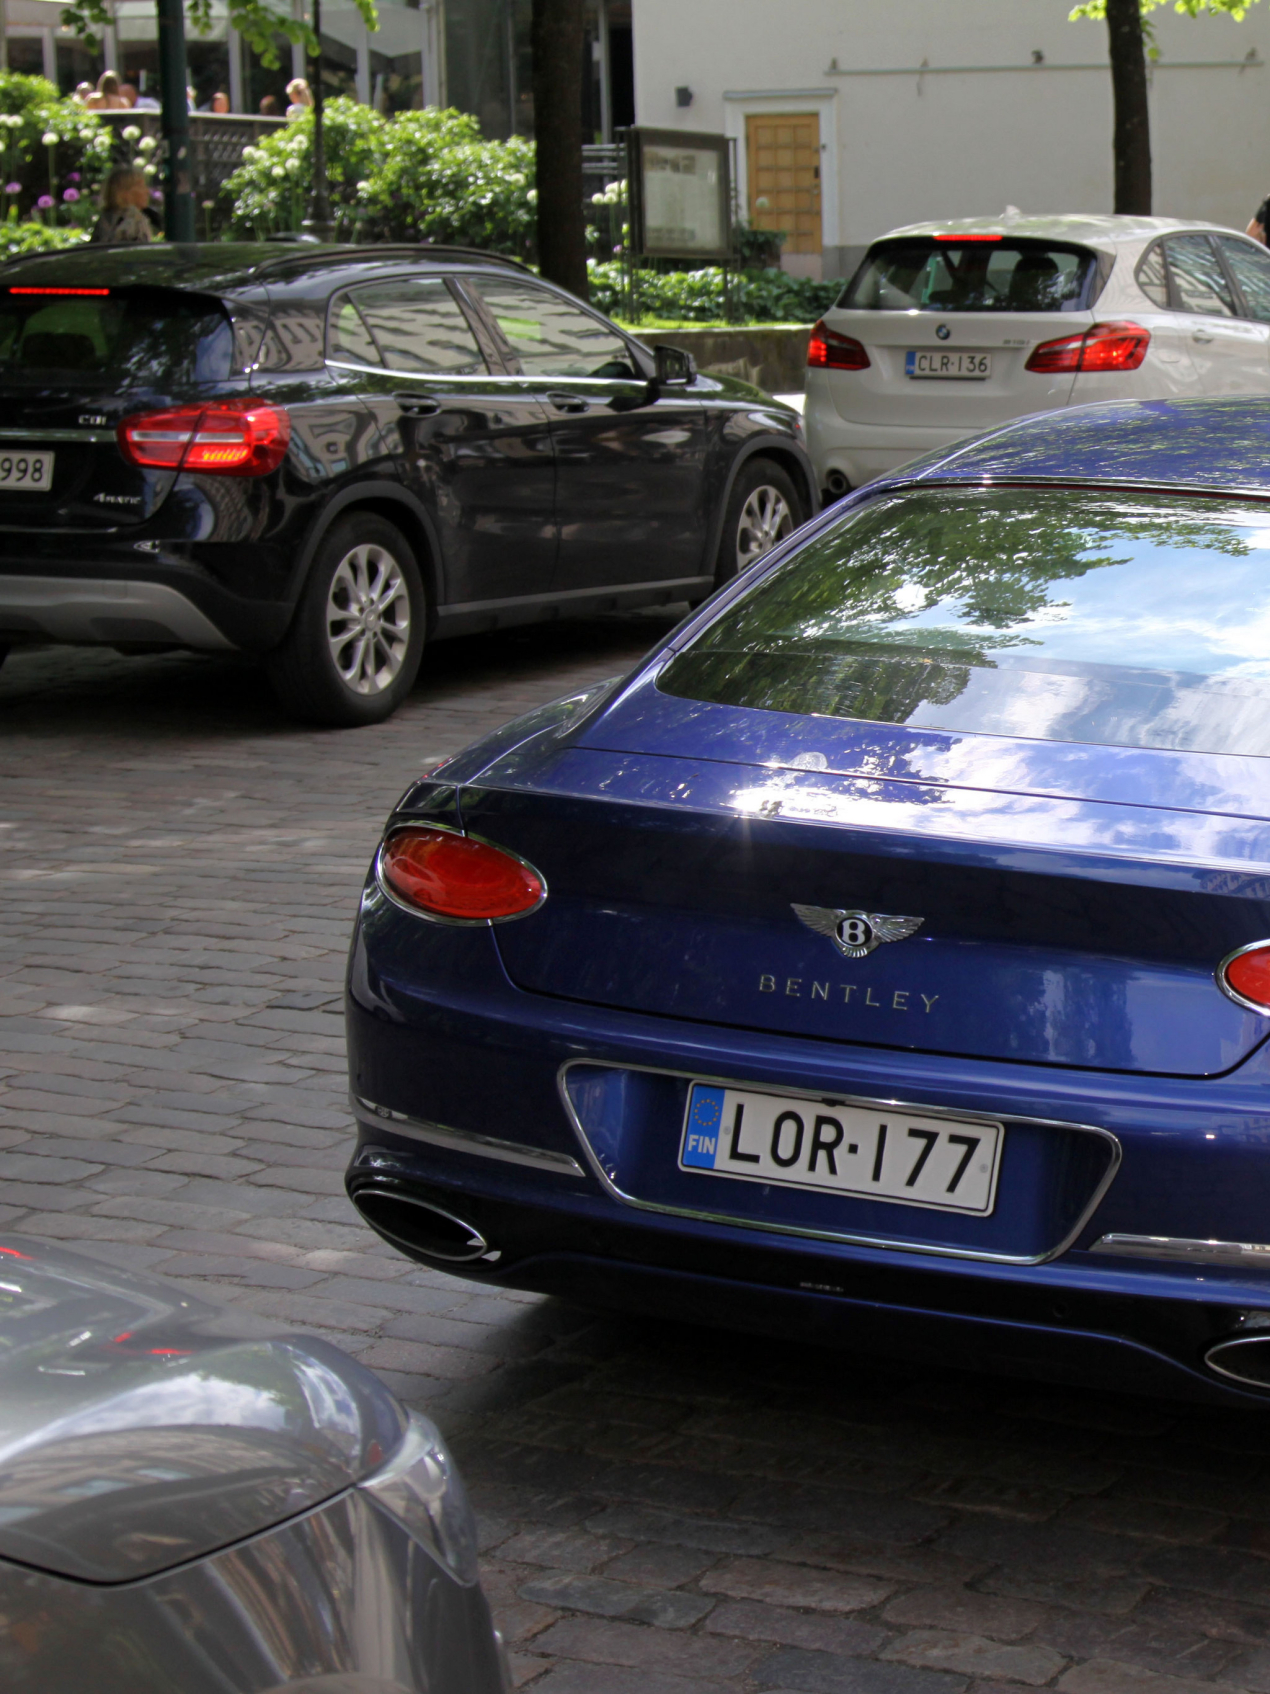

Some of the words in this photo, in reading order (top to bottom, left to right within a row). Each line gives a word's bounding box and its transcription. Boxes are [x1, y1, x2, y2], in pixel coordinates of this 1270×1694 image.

[0, 457, 44, 482] 998
[842, 918, 866, 945] B
[758, 973, 940, 1014] BENTLEY
[687, 1133, 716, 1155] FIN
